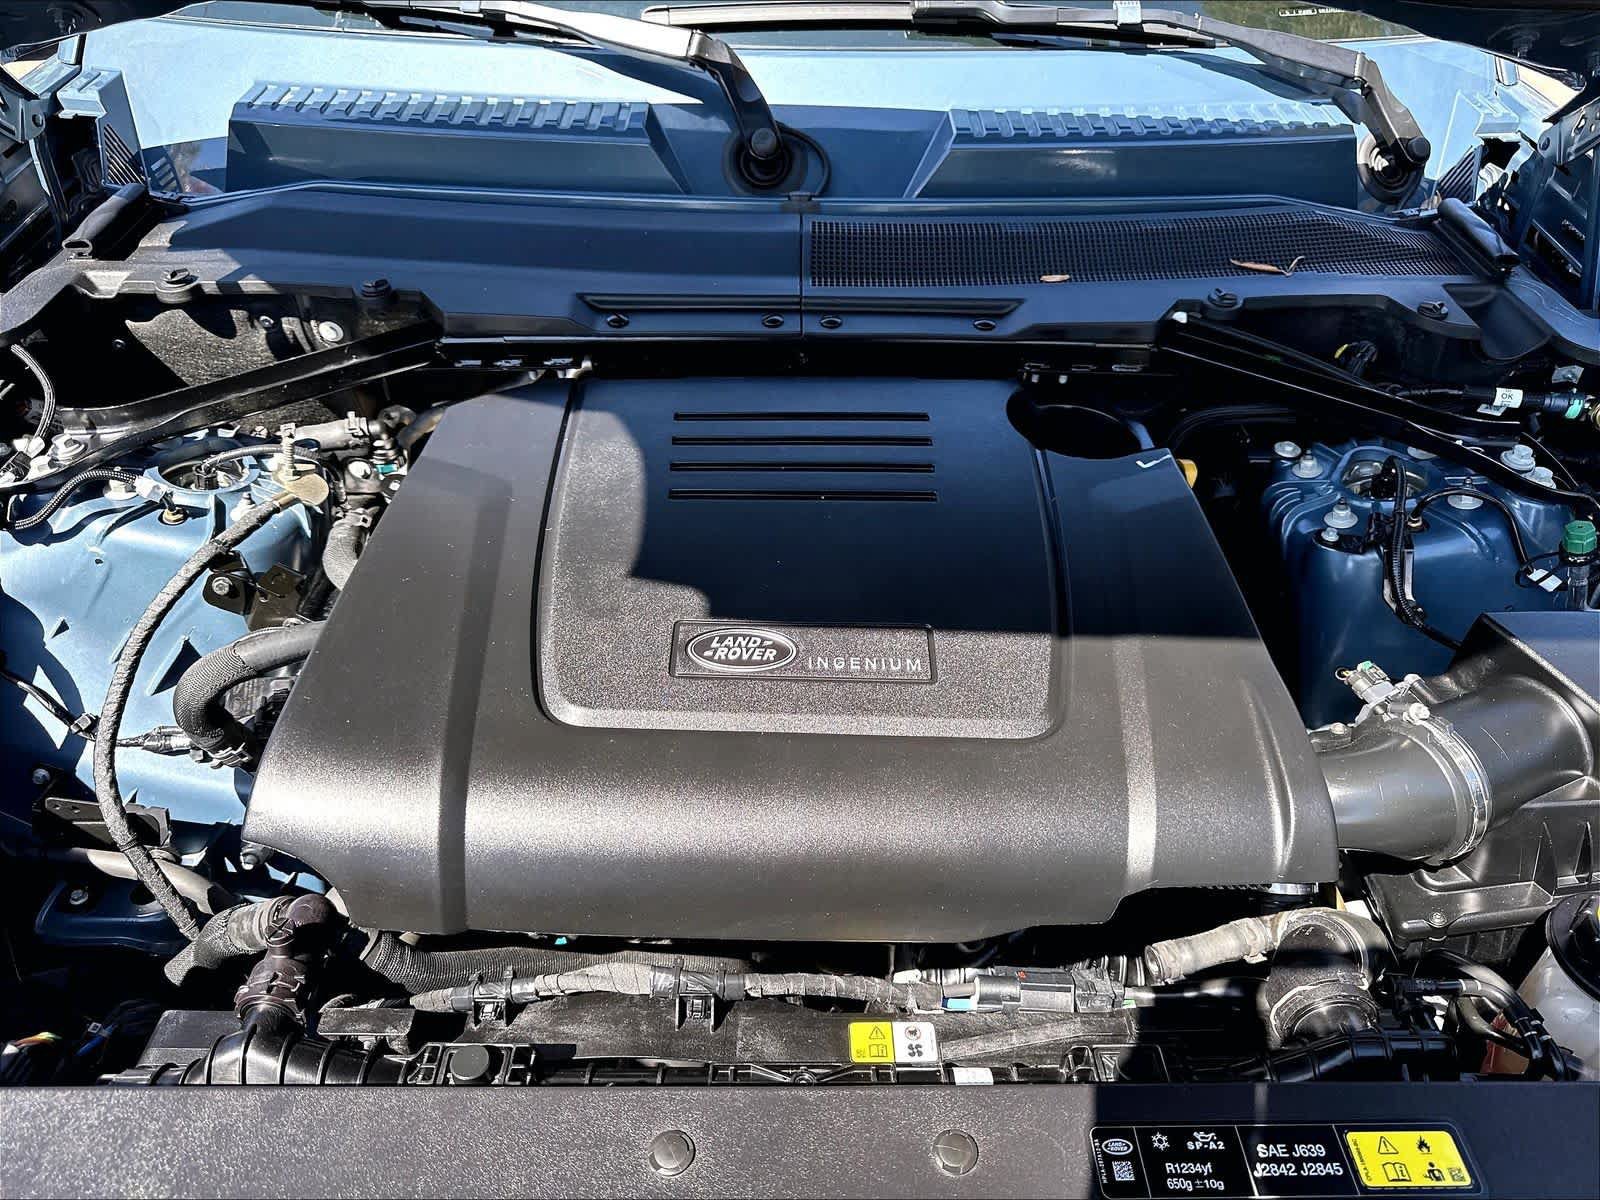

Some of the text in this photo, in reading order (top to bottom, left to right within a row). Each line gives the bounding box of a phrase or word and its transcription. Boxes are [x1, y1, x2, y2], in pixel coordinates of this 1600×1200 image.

[1501, 392, 1513, 400] OK
[711, 636, 762, 648] LAND
[713, 647, 777, 660] ROVER
[808, 656, 922, 672] INGENIUM
[1186, 1140, 1226, 1150] SP-A2
[1257, 1143, 1326, 1158] SAE J639
[1165, 1162, 1213, 1175] R1234yf
[1253, 1162, 1344, 1177] J2842 J2845
[1166, 1178, 1193, 1191] 650g
